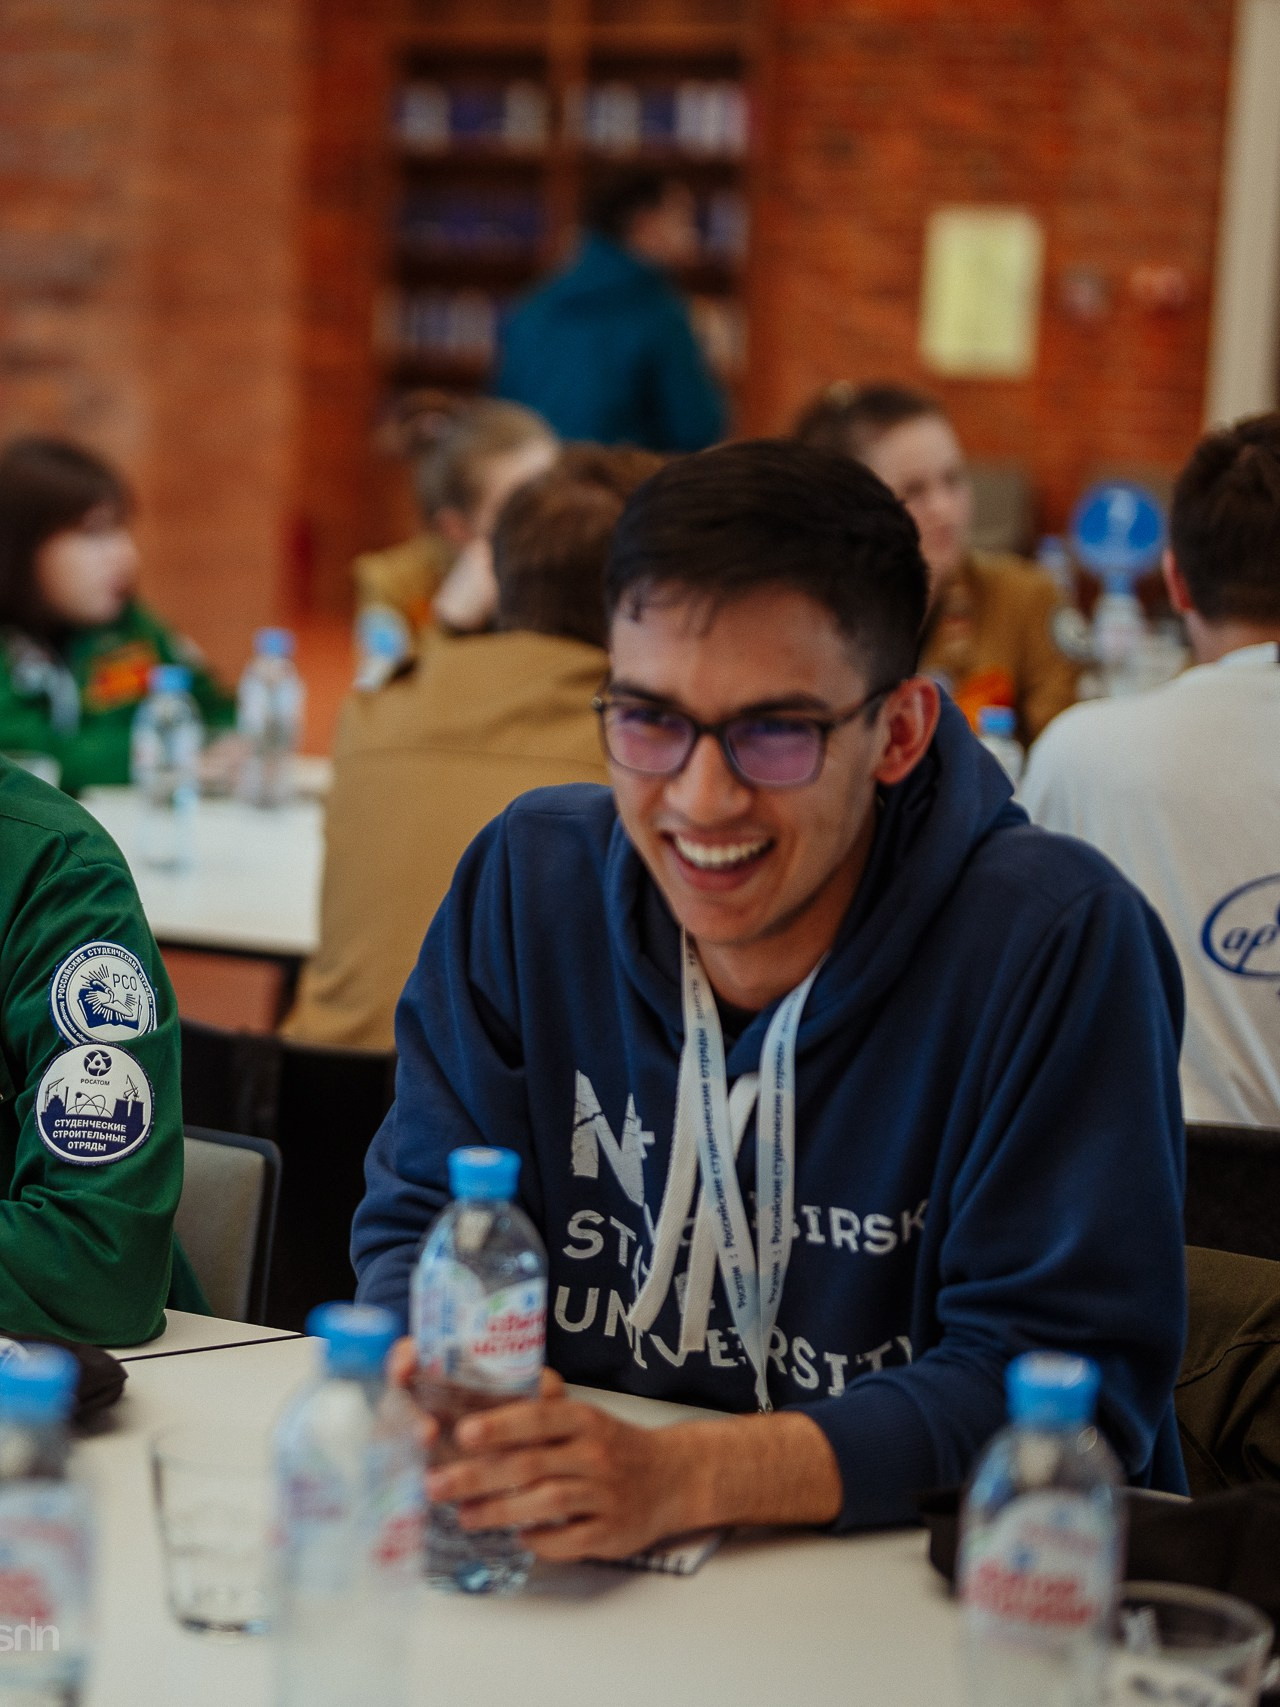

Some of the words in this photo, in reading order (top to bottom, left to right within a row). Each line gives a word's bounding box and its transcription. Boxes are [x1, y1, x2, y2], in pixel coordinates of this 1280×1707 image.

[57, 953, 87, 999] РОССИЙСКИЕ
[112, 973, 138, 992] РСО
[80, 1078, 111, 1086] РОСАТОМ
[52, 1130, 127, 1143] СТРОИТЕЛЬНЫЕ
[54, 1119, 127, 1132] СТУДЕНЧЕСКИЕ
[701, 1081, 721, 1175] студенческие
[772, 1093, 787, 1176] студенческие
[67, 1141, 107, 1151] ОТРЯДЫ
[714, 1178, 735, 1248] Российские
[770, 1178, 784, 1245] Российские
